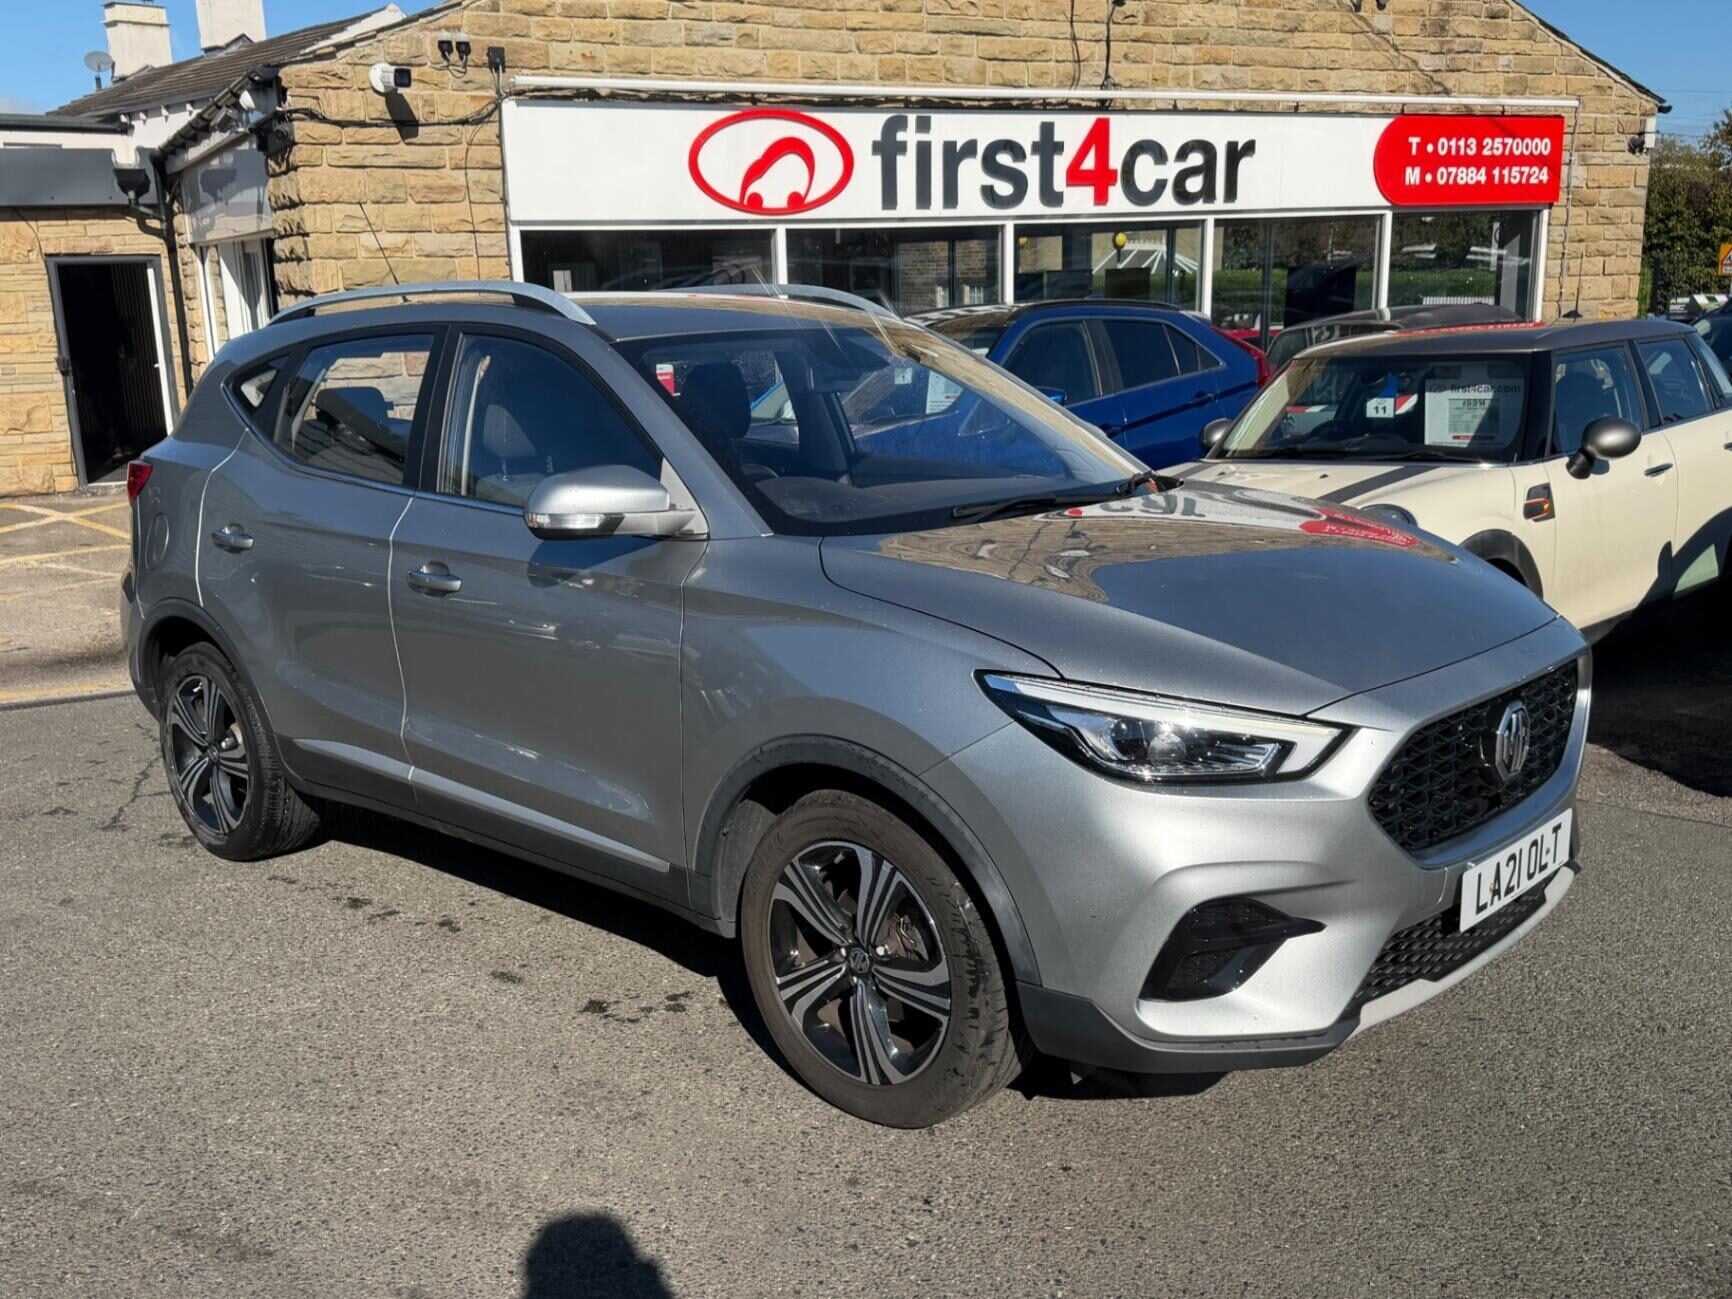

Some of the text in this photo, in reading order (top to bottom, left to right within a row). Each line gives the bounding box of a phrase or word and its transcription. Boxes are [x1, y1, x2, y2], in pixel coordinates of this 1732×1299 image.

[1408, 136, 1552, 156] T 0113 2570000
[872, 115, 1256, 210] first4car
[1405, 165, 1549, 186] M 07884 115724
[1373, 405, 1386, 415] 11
[1475, 821, 1562, 916] LA21 OLT
